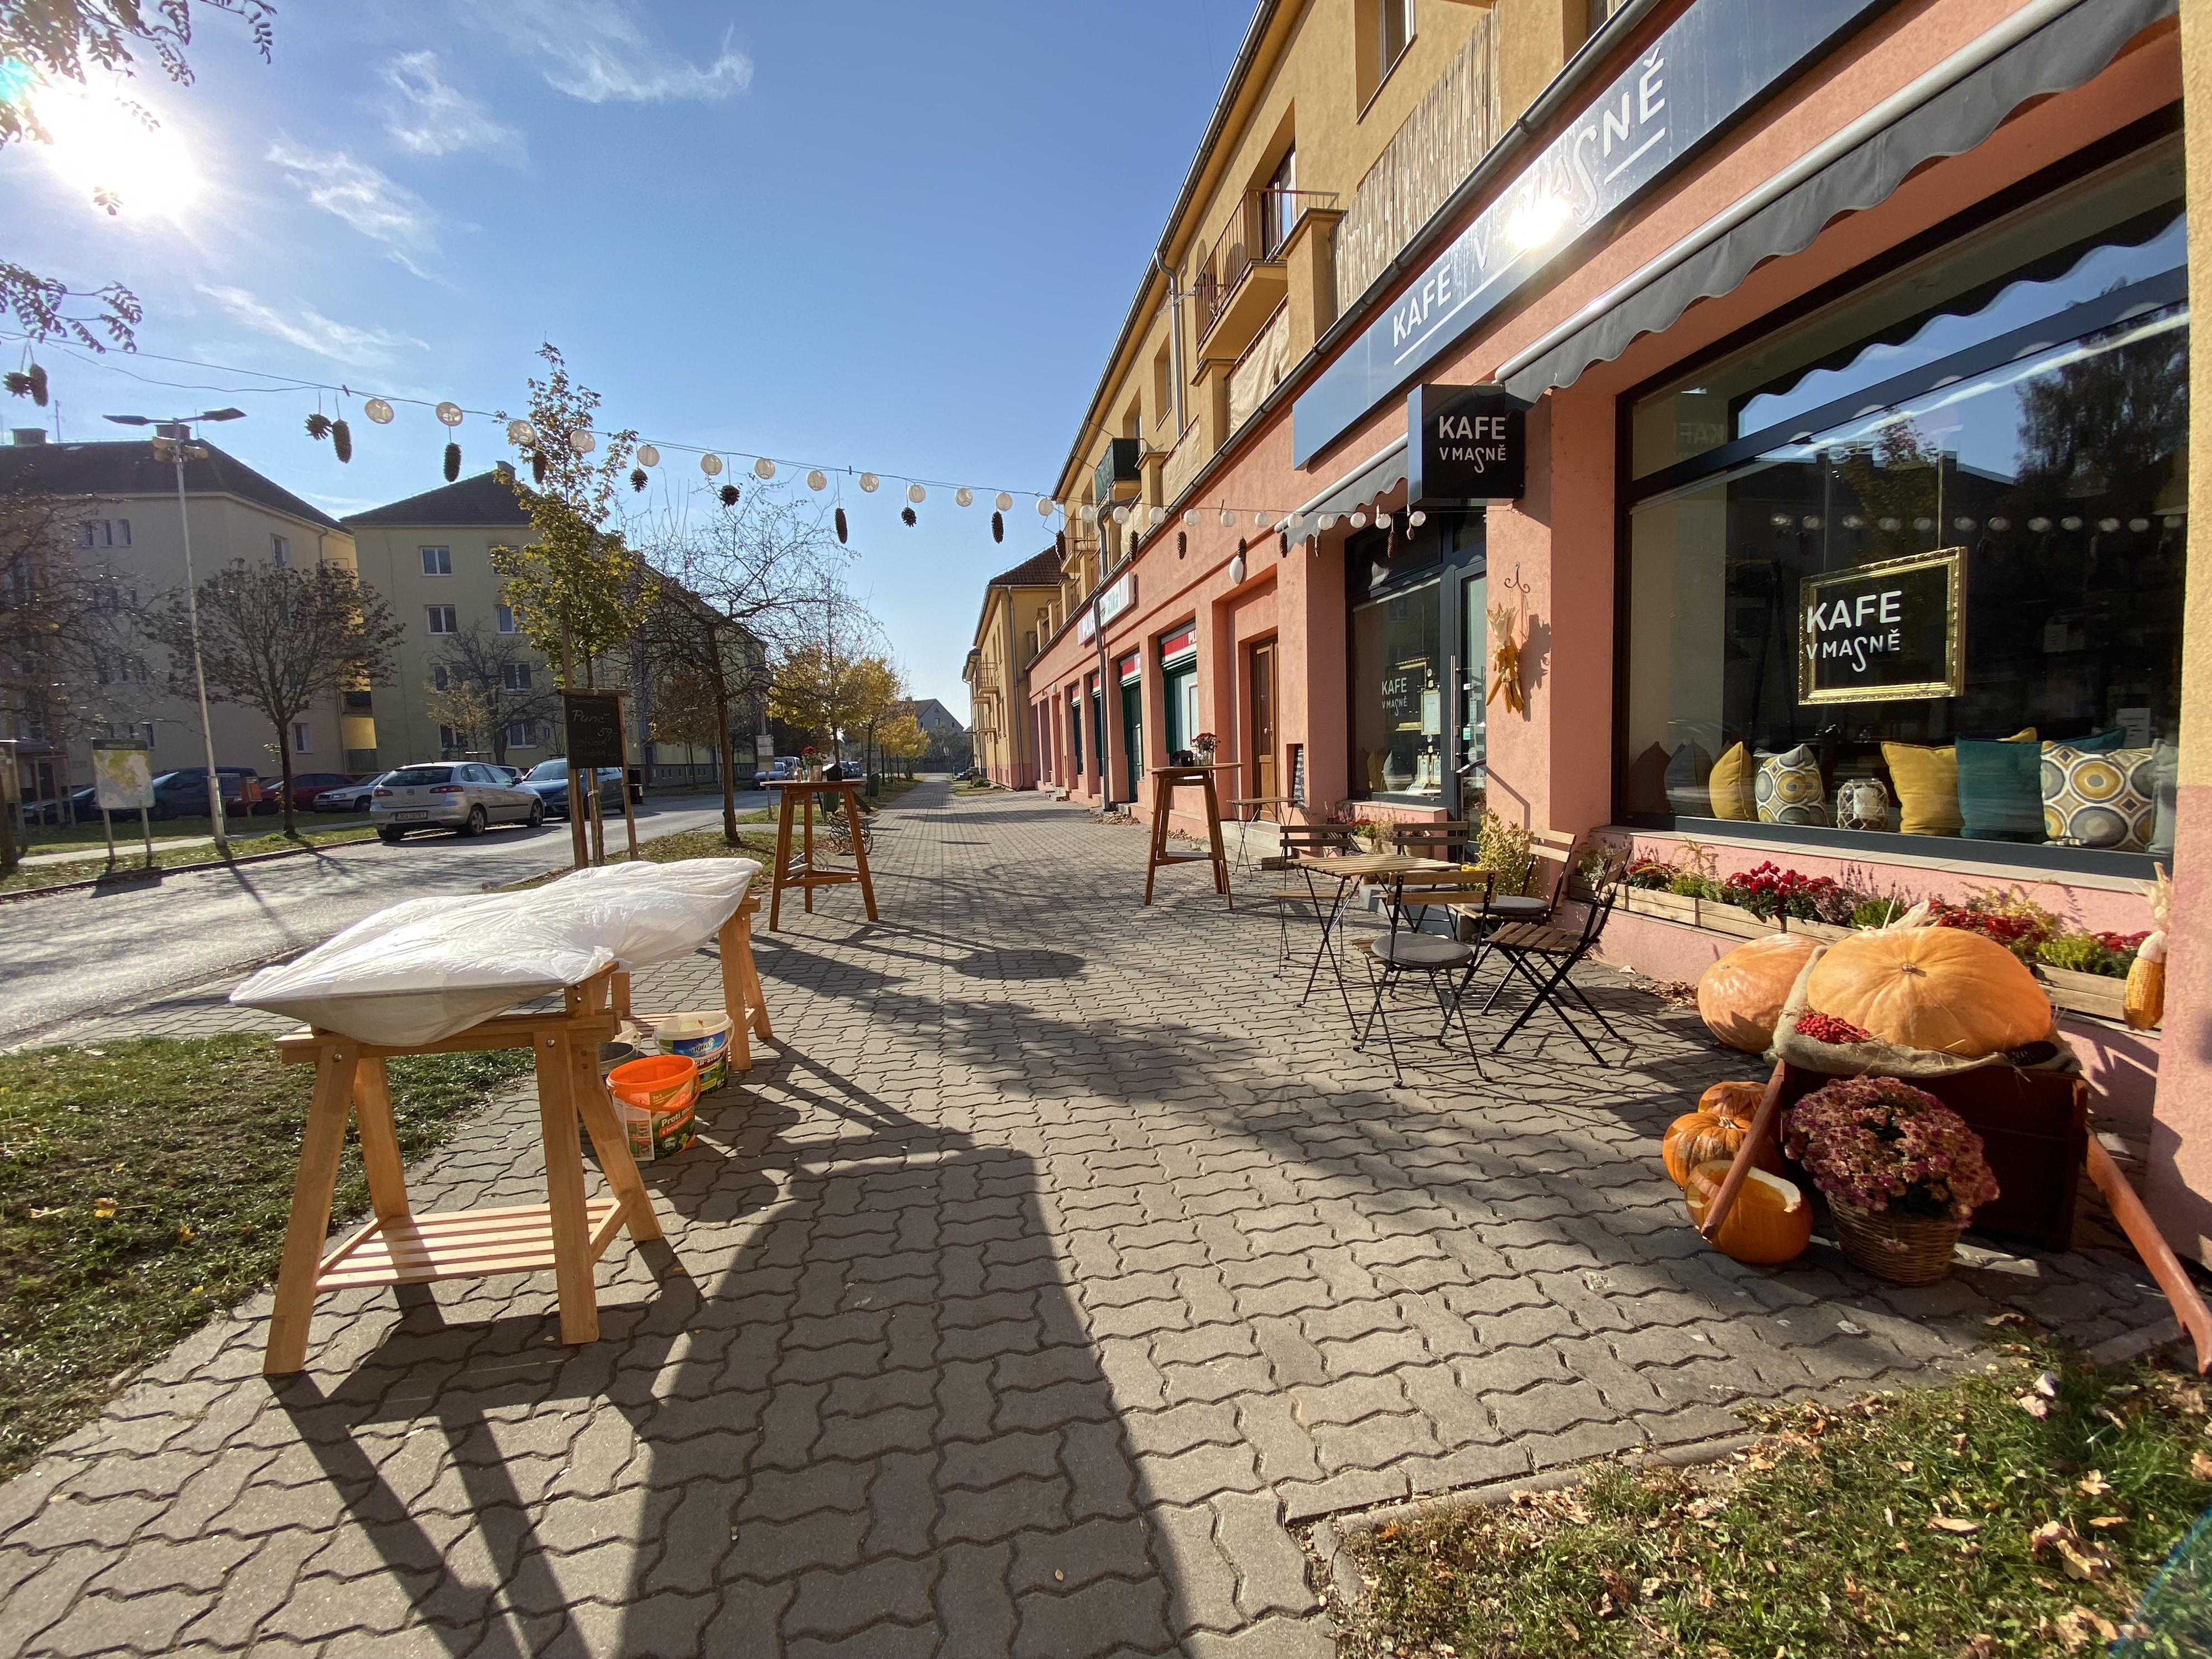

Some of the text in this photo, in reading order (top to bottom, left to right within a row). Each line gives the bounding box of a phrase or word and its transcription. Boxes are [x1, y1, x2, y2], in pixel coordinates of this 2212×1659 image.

[1394, 263, 1452, 348] KAFE
[1474, 222, 1493, 269] V
[1439, 415, 1506, 440] KAFE
[1439, 444, 1506, 473] V MASNĚ
[1806, 590, 1902, 634] KAFE
[1806, 629, 1901, 672] V MASNĚ
[1381, 677, 1407, 696] KAFE
[1381, 696, 1407, 717] V MASNĚ
[661, 1110, 681, 1127] Proti
